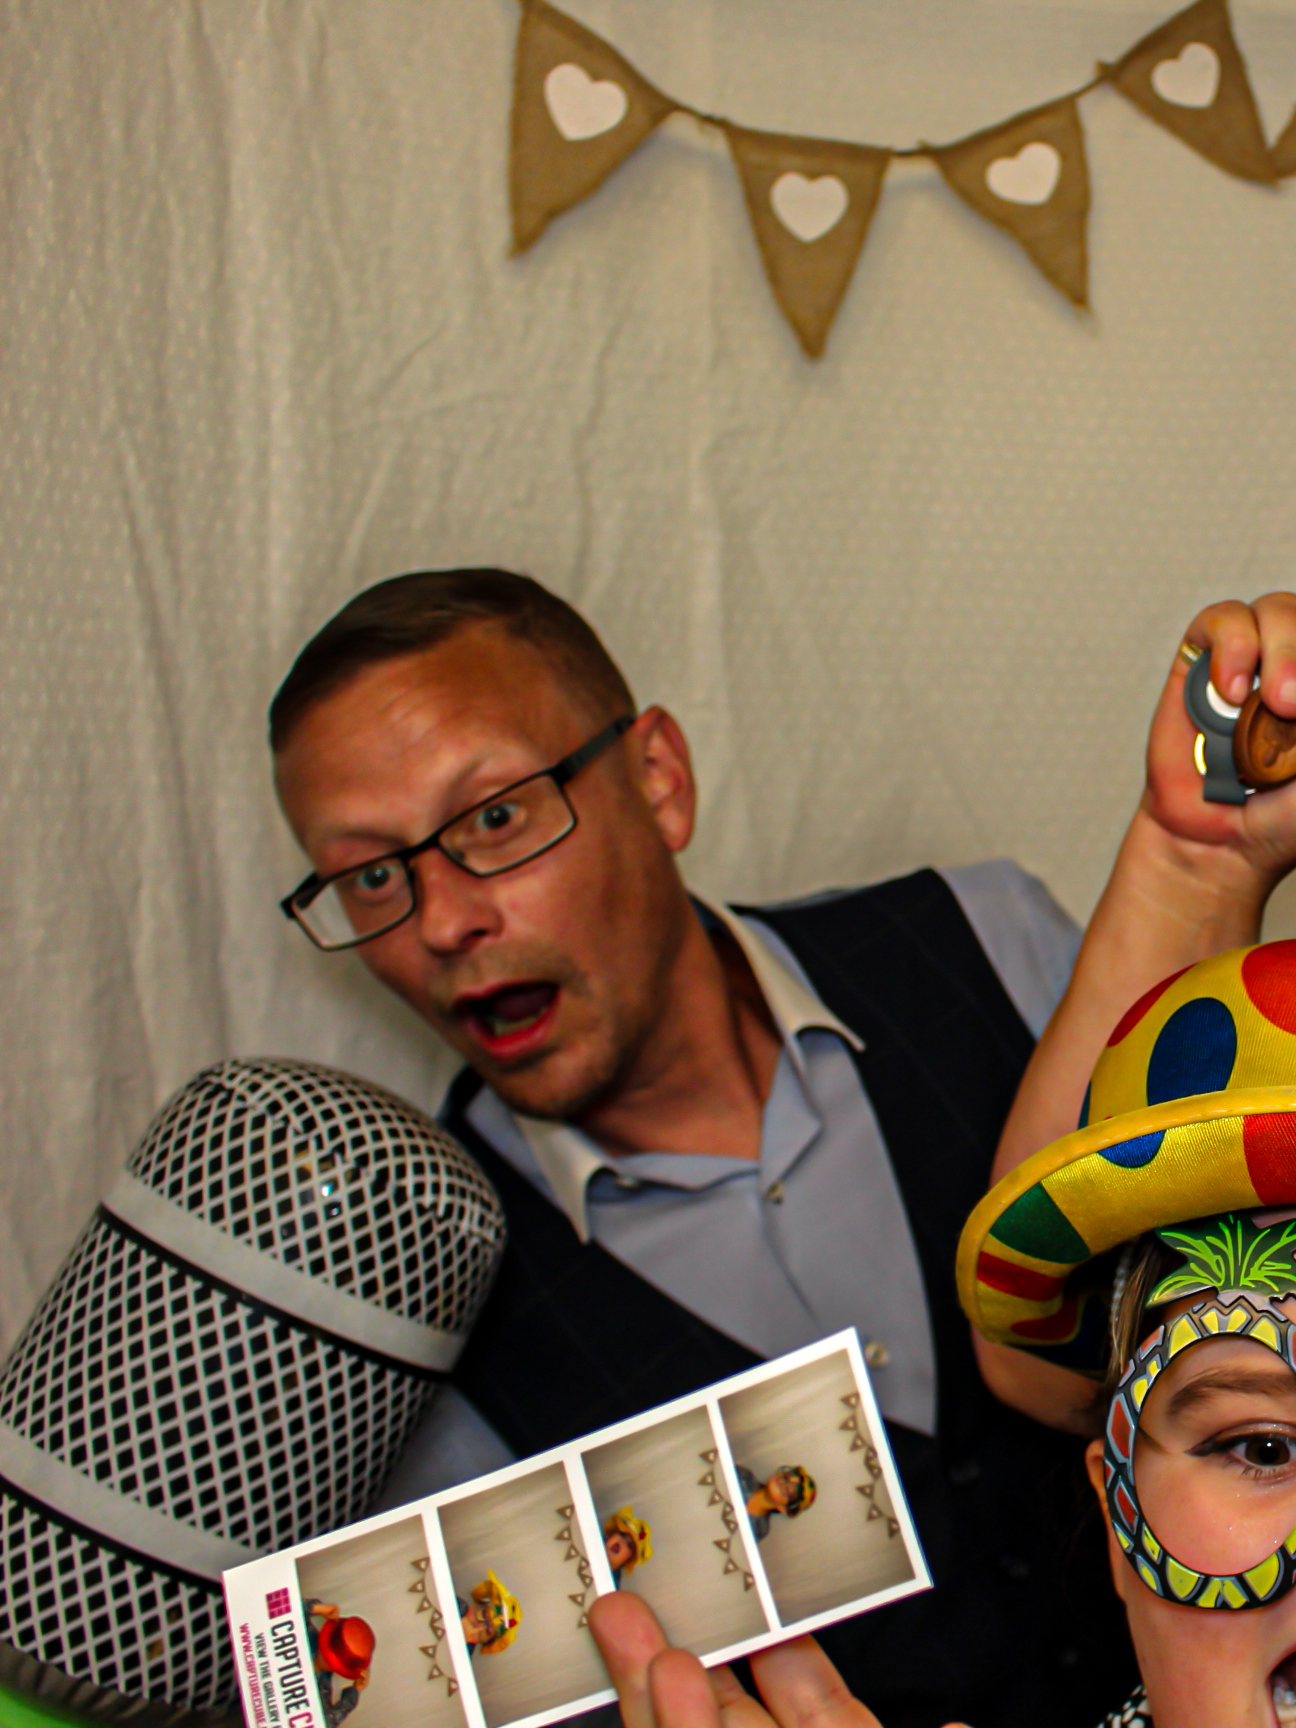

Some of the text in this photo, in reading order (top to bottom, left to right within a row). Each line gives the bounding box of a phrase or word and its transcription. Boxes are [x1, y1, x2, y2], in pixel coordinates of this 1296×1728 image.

[254, 1632, 267, 1658] VIEW
[239, 1622, 268, 1728] WWW.CAPTURECUBE.
[259, 1661, 272, 1679] THE
[263, 1681, 280, 1722] GALLERY
